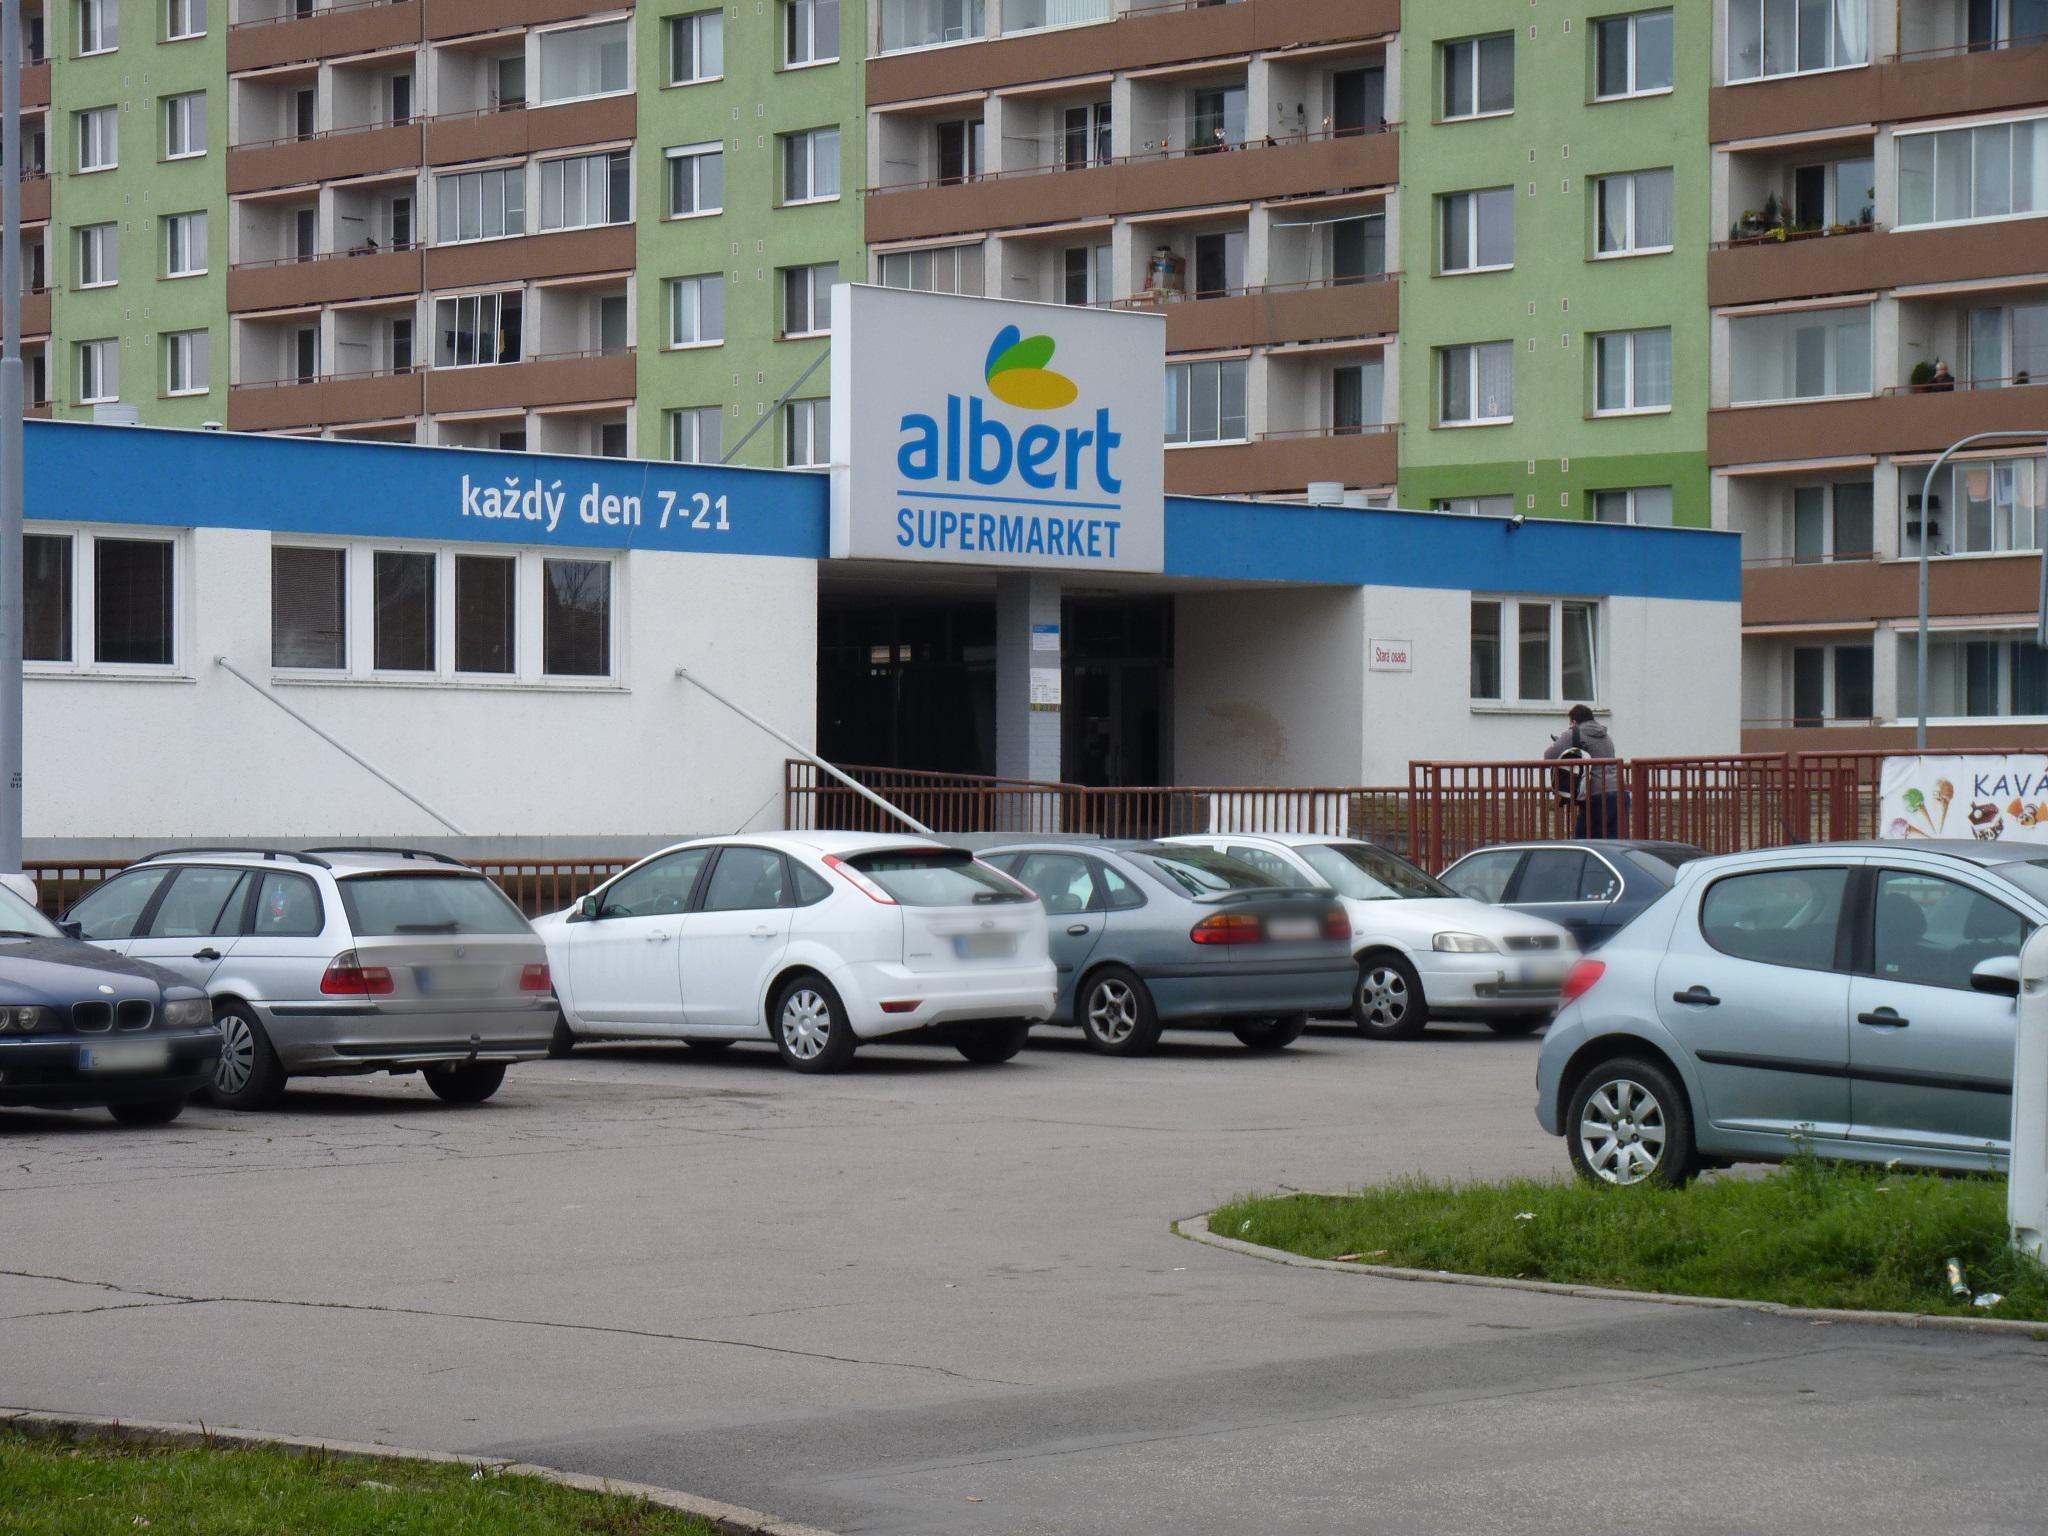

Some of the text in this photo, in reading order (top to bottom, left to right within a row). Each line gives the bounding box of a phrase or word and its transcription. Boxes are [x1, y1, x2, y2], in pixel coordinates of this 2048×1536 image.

[896, 393, 1122, 494] albert
[462, 474, 731, 533] každý den 7-21
[896, 507, 1122, 558] SUPERMARKET
